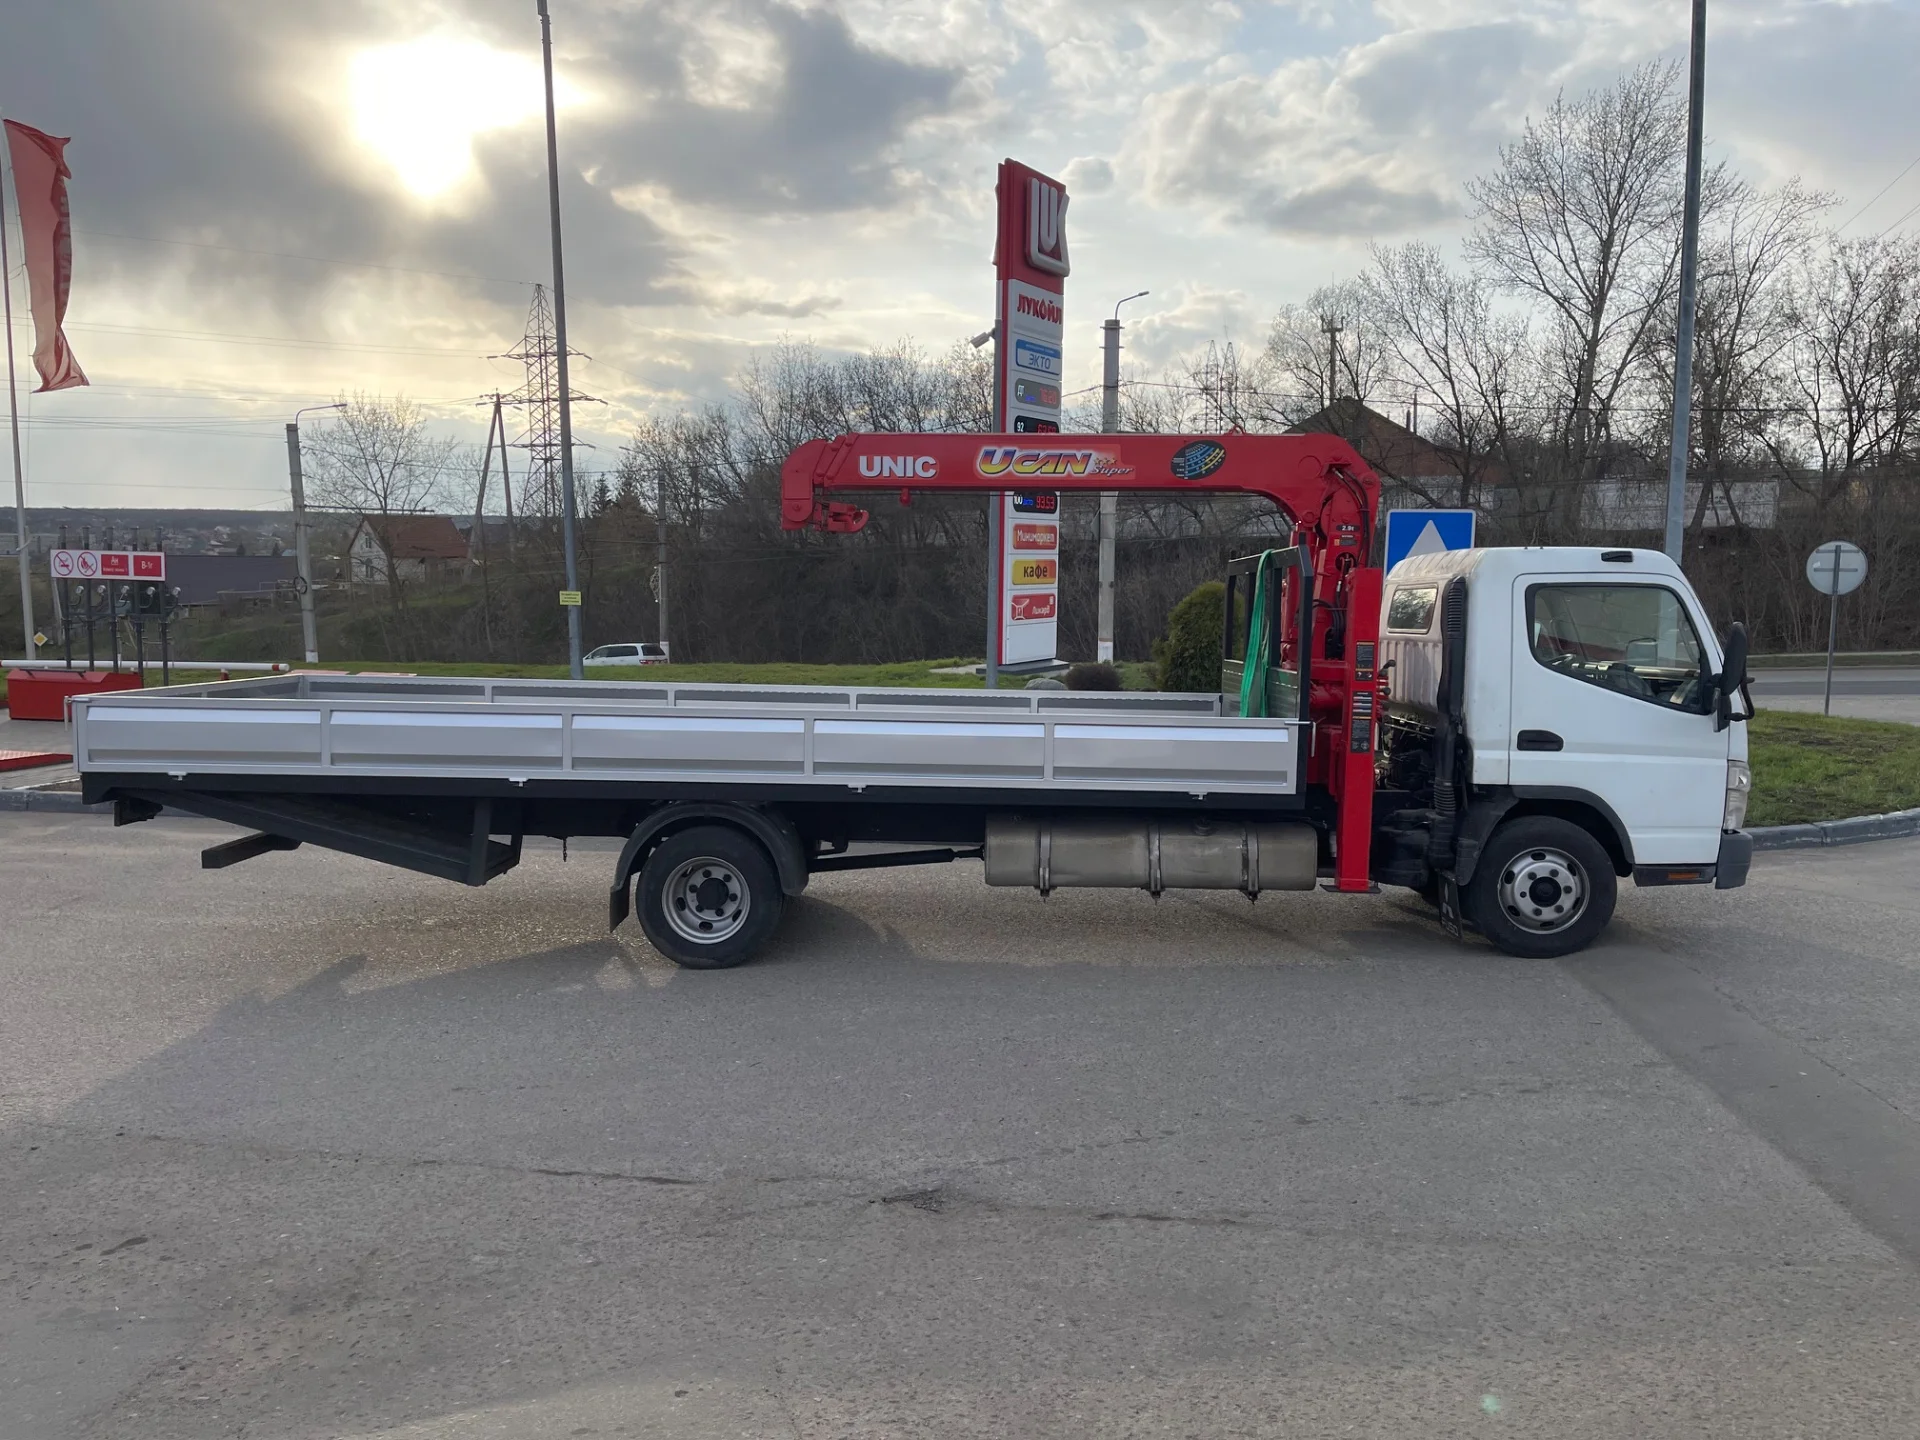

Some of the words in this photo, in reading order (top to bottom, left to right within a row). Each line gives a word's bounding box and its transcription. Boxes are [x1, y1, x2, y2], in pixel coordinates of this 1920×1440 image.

[1017, 293, 1062, 325] ЛУКОЙЛ
[1028, 353, 1052, 370] ЭКТО
[1016, 421, 1025, 433] 92
[858, 455, 938, 478] UNIC
[1090, 464, 1134, 476] Super
[1016, 528, 1055, 546] Минимаркет
[1023, 564, 1048, 579] кафе
